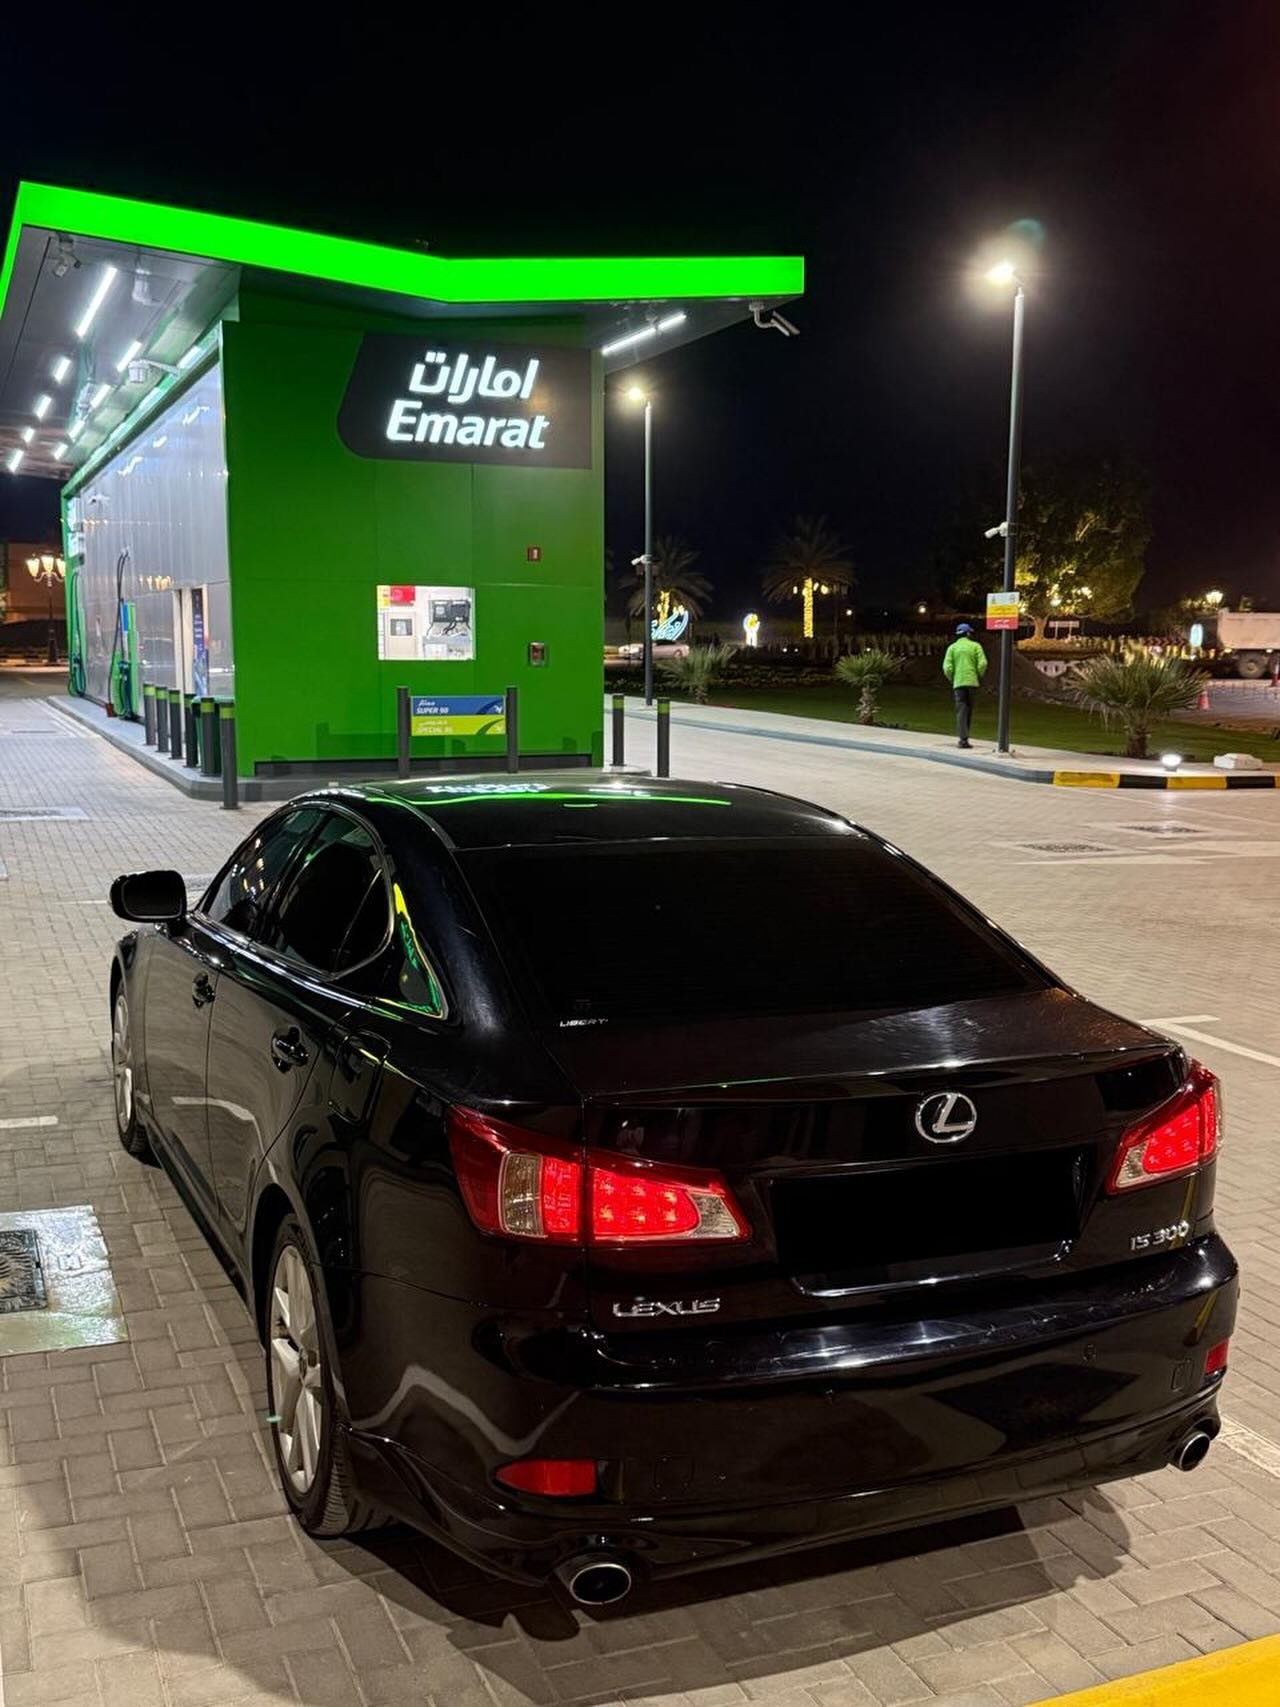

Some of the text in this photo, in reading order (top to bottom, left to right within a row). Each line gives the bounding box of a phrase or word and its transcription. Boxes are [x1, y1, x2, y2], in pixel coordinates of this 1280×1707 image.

[387, 399, 549, 449] Emarat
[1130, 1219, 1190, 1250] IS 300
[612, 1297, 721, 1317] LEXUS
